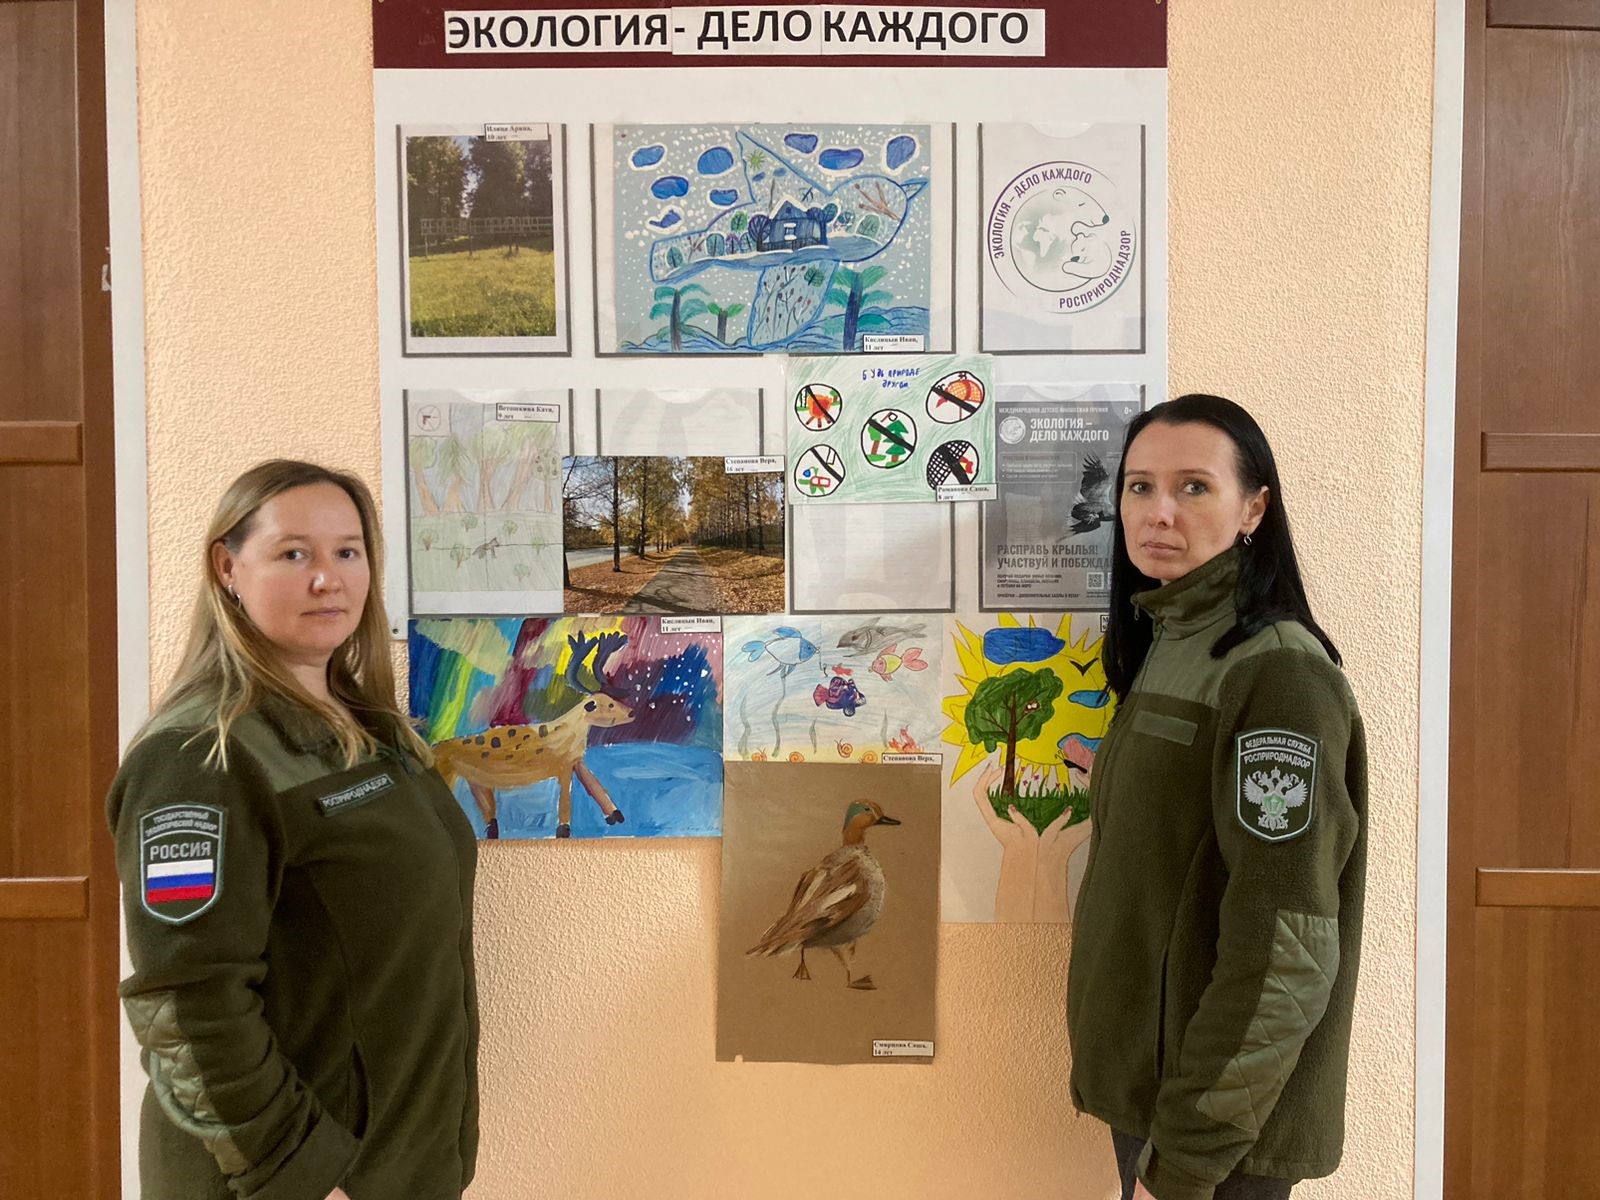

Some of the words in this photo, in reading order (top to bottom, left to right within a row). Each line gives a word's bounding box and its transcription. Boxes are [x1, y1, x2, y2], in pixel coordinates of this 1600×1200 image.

[697, 10, 812, 50] ДЕЛО
[823, 11, 1029, 51] КАЖДОГО
[991, 202, 1012, 259] ЭКОЛОГИЯ
[1013, 174, 1040, 198] ДЕЛО
[1041, 168, 1092, 184] КАЖДОГО
[1059, 230, 1131, 309] РОСПРИРОДНАДЗОР
[1030, 418, 1083, 429] ЭКОЛОГИЯ
[1029, 430, 1058, 443] ДЕЛО
[1060, 430, 1109, 443] КАЖДОГО
[997, 545, 1049, 555] РАСПРАВЬ
[1051, 545, 1098, 555] КРЫЛЬЯ!
[997, 557, 1049, 569] УЧАСТВУЙ
[1051, 558, 1058, 568] И
[1061, 558, 1113, 569] ПОБЕЖДА
[1245, 736, 1286, 749] ФЕДЕРАЛЬНАЯ
[1287, 739, 1312, 754] СЛУЖБА
[1244, 752, 1311, 769] РОСПРИРОДНАДЗОР
[150, 841, 211, 860] РОССИЯ
